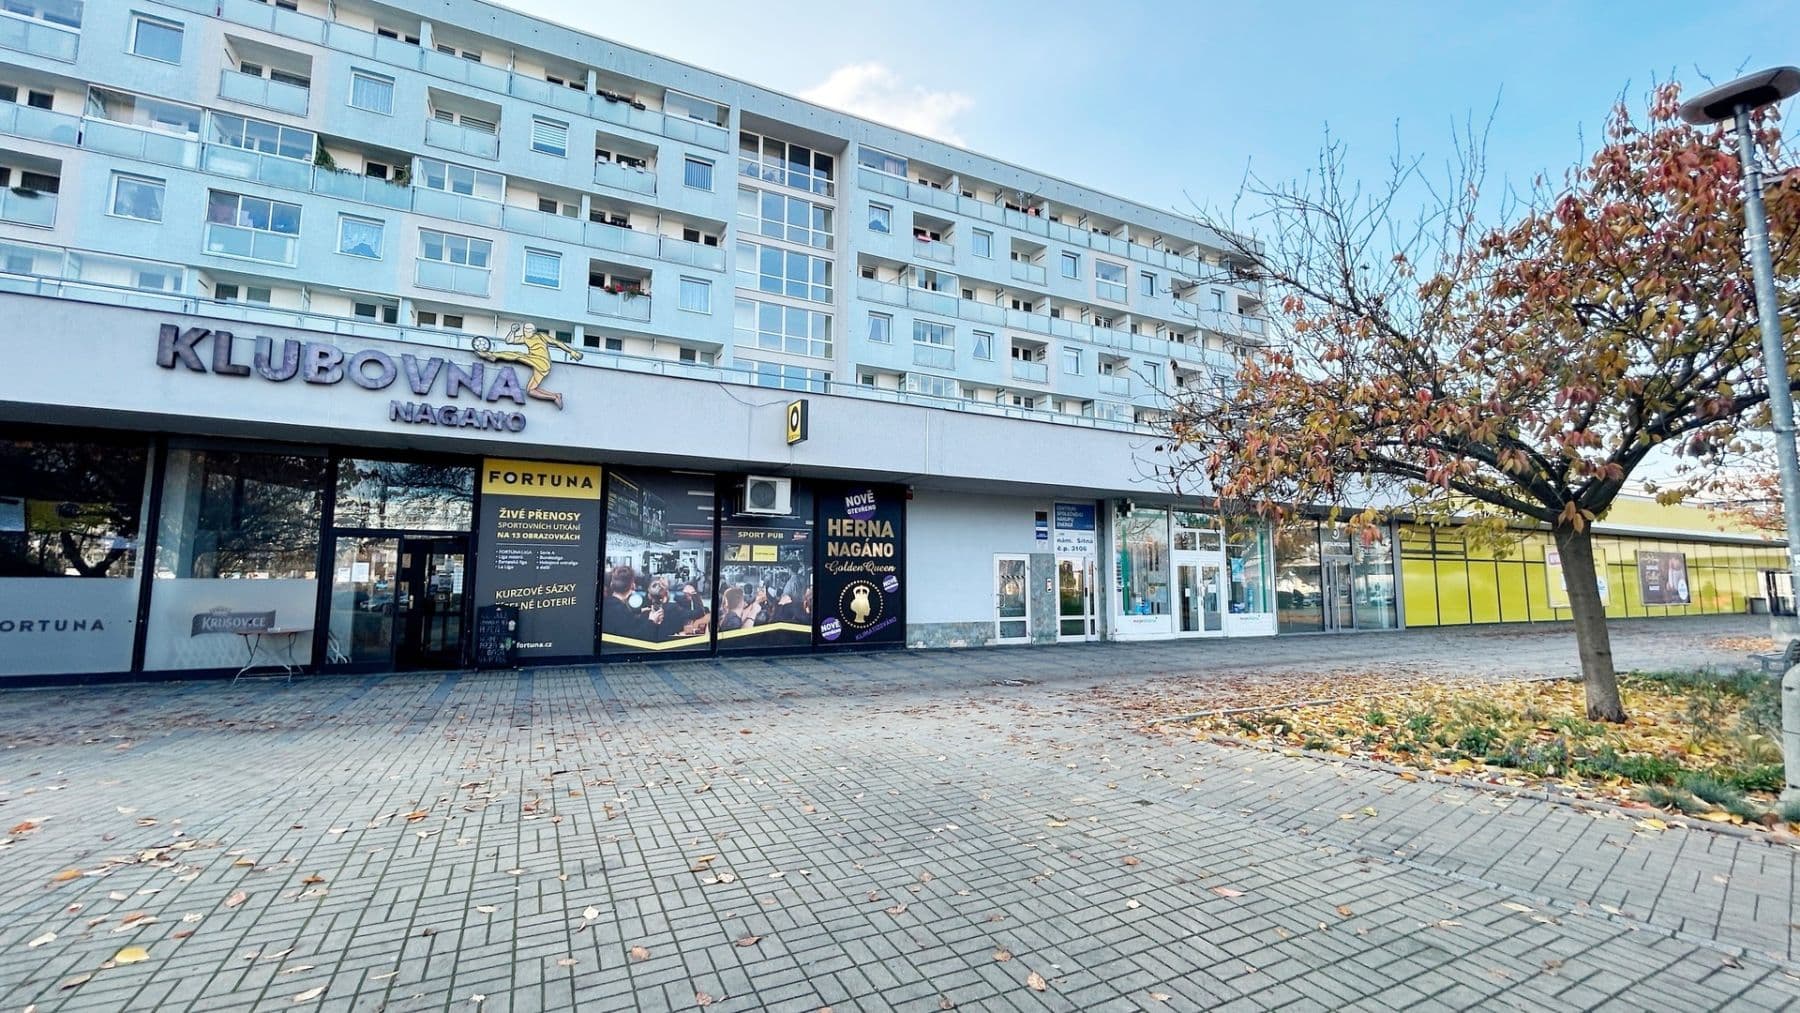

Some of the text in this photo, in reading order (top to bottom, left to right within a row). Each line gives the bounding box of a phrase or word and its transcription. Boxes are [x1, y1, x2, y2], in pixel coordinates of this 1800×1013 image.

[156, 322, 526, 405] KLUBOVNA
[389, 399, 527, 433] NAGANO
[489, 470, 593, 489] FORTUNA
[499, 507, 581, 521] ŽIVÉ PŘENOSY
[497, 521, 581, 531] SPORTOVNÍCH UTKÁNÍ
[827, 518, 894, 538] HERNA
[497, 531, 510, 539] NA
[522, 531, 580, 541] OBRAZOVKÁCH
[738, 531, 765, 539] SPORT
[827, 537, 894, 557] NAGÁNO
[825, 560, 896, 575] Golden Queen
[495, 583, 577, 600] KURZOVÉ SÁZKY
[537, 596, 577, 609] LOTERIE
[516, 641, 552, 649] fortuna.cz
